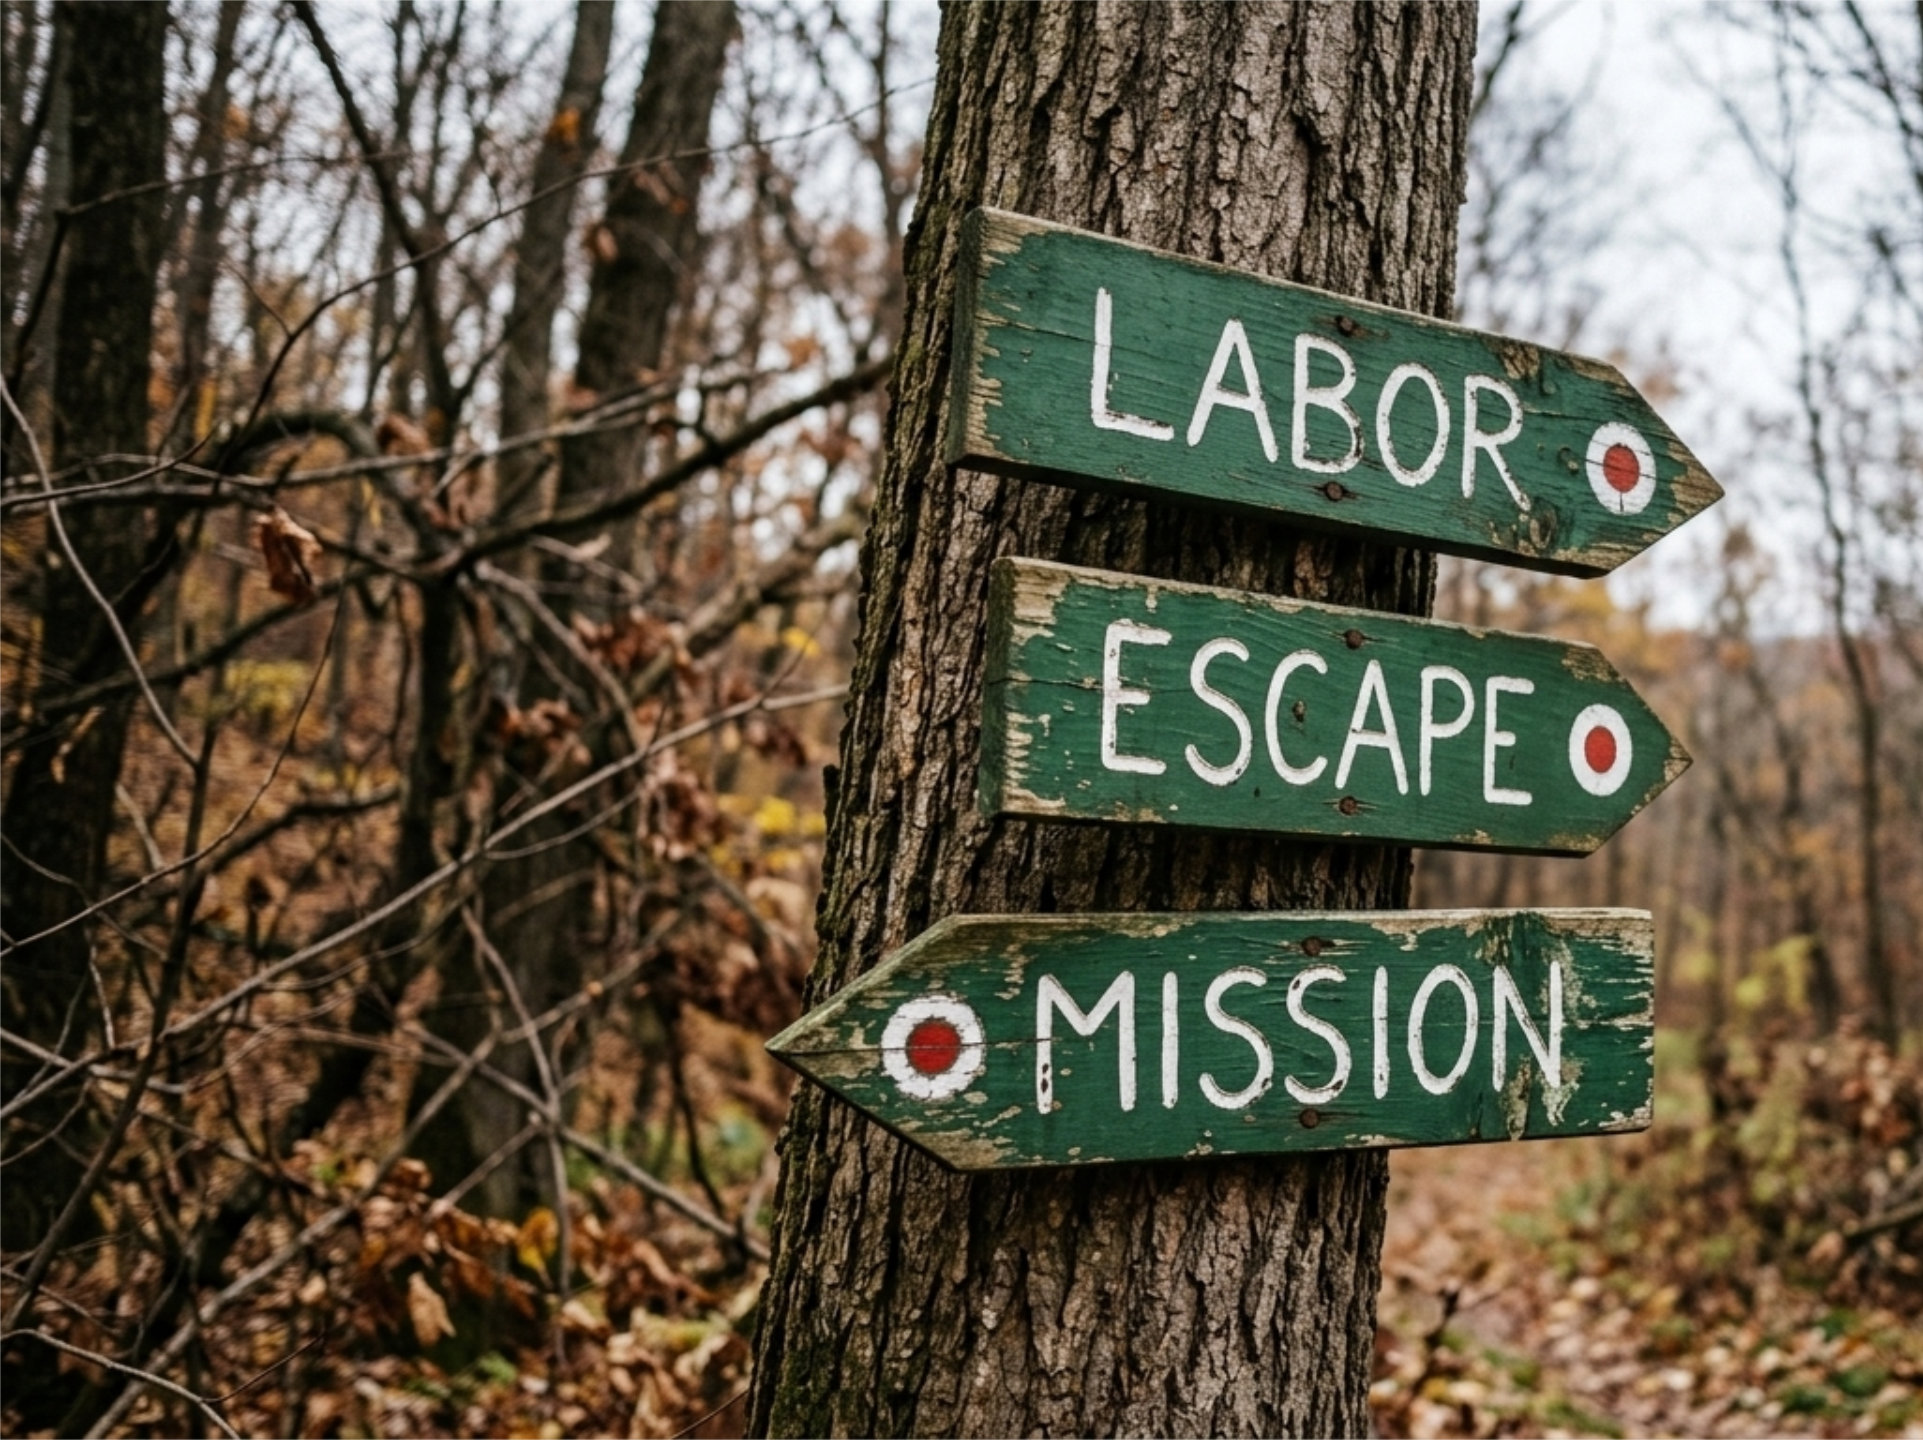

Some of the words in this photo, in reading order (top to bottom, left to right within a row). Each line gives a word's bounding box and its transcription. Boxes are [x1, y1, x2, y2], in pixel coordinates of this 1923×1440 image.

[1090, 287, 1531, 511] LABOR
[1101, 618, 1535, 807] ESCAPE
[1035, 960, 1563, 1114] MISSION
